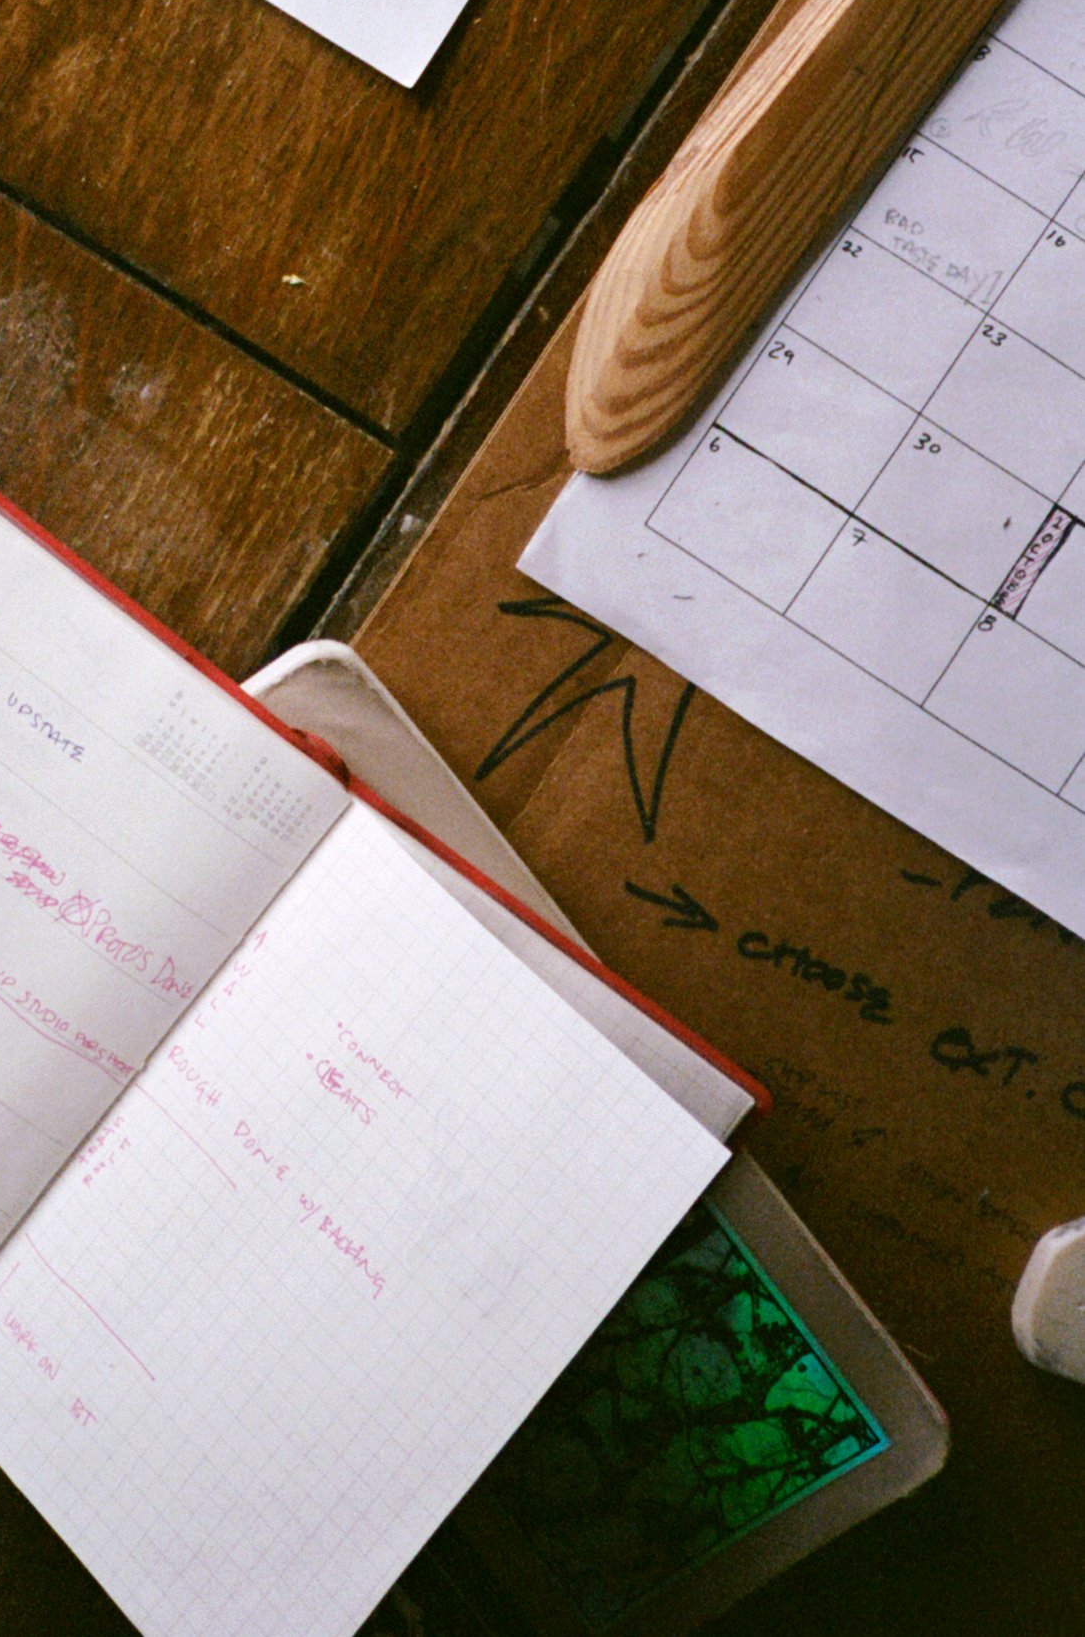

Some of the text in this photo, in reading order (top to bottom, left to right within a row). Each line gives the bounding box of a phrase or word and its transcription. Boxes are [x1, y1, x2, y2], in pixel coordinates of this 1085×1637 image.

[981, 322, 1009, 349] 23
[766, 339, 796, 367] 29
[708, 436, 722, 455] 6
[913, 432, 943, 457] 30
[849, 527, 869, 548] 7
[977, 614, 998, 633] 8
[338, 1027, 413, 1102] CONNECT
[167, 1044, 223, 1108] ROUGH
[232, 1119, 292, 1183] DONE
